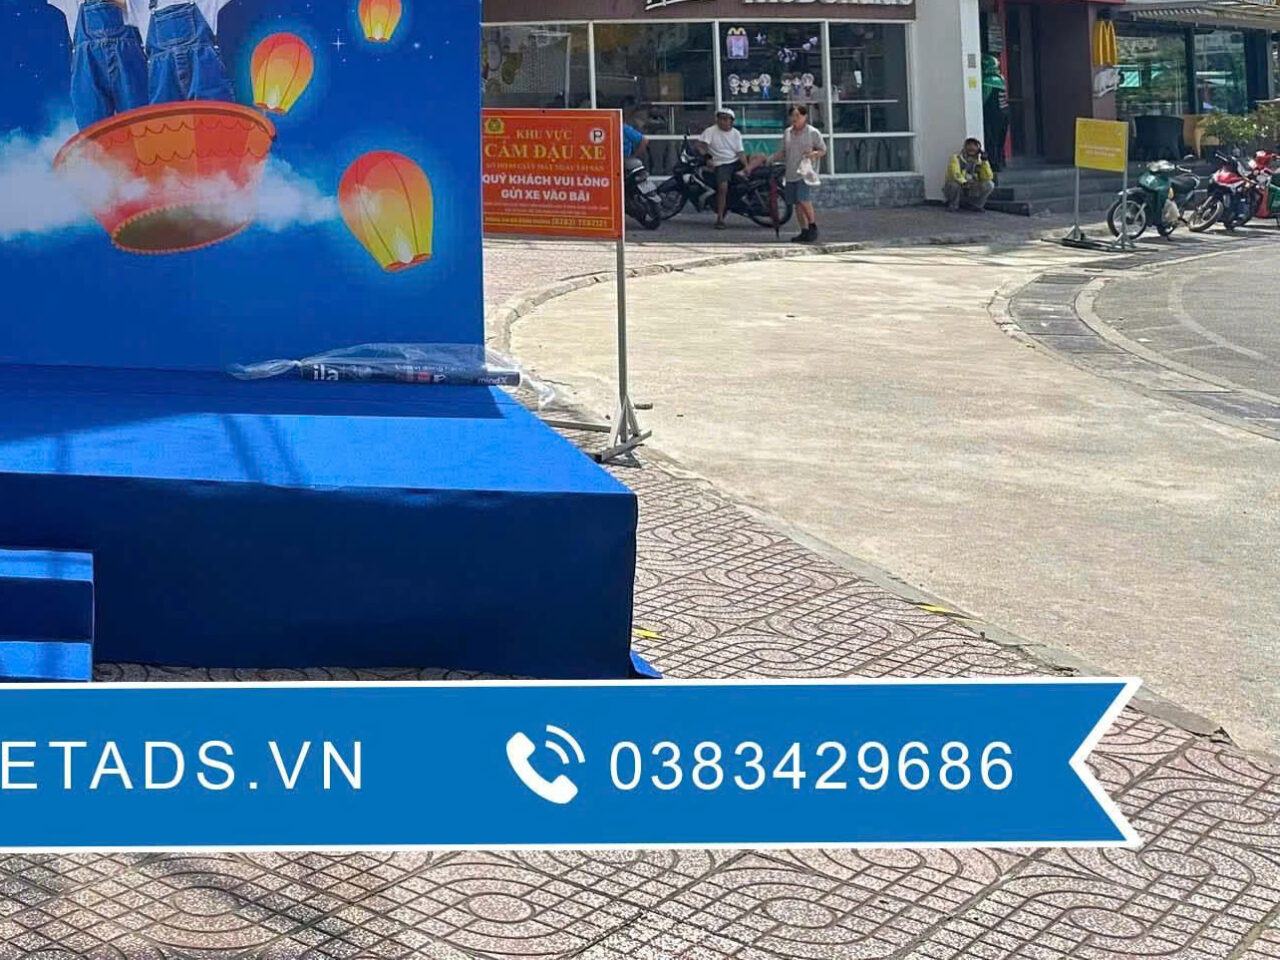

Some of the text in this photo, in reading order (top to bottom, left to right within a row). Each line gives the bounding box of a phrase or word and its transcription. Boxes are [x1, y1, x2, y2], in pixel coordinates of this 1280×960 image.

[516, 129, 541, 139] KHU
[580, 145, 605, 160] XE
[509, 173, 551, 185] KHÁCH
[553, 176, 574, 186] VUI
[577, 175, 609, 187] LÒNG
[525, 190, 539, 200] XE
[542, 189, 566, 200] VÀO
[313, 364, 339, 381] ila
